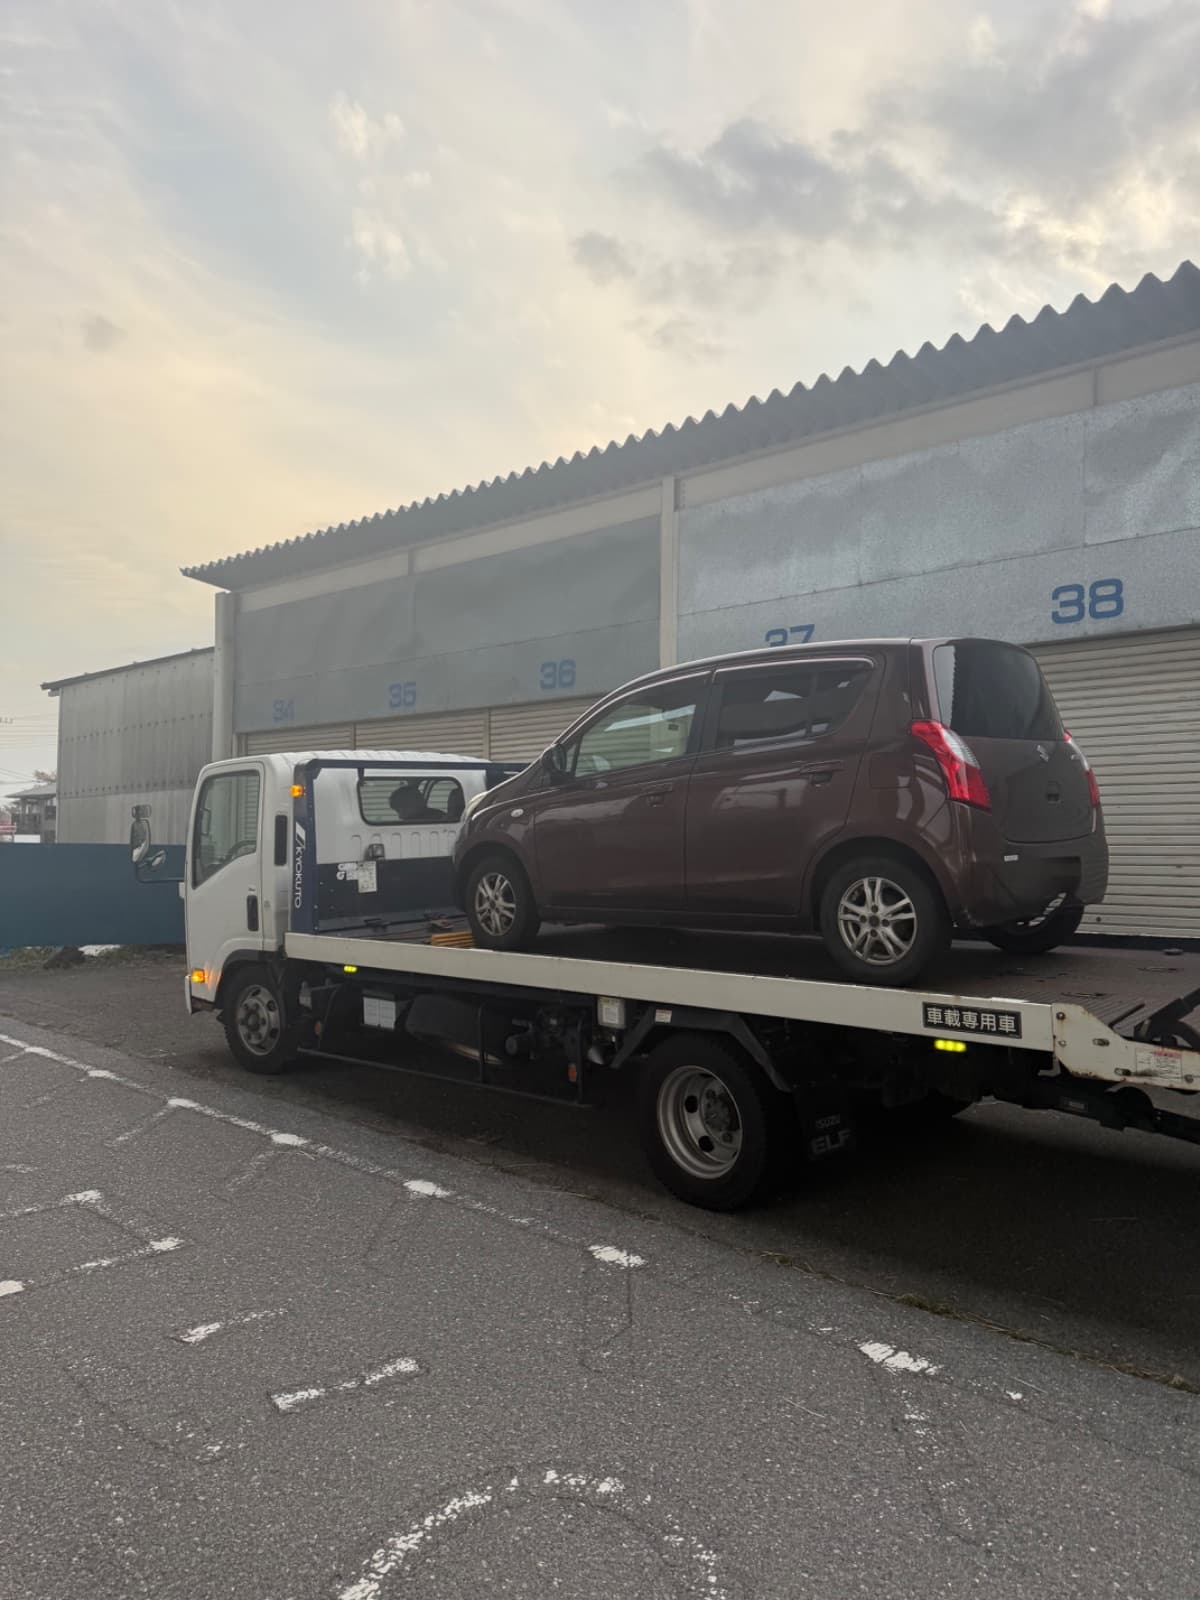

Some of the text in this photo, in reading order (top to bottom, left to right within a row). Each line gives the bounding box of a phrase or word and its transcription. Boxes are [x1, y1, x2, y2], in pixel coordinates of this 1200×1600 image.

[1051, 578, 1124, 624] 38
[764, 624, 815, 648] 37
[540, 659, 576, 689] 36
[389, 681, 416, 708] 35
[294, 846, 303, 909] KYOKUTO
[926, 1007, 1017, 1033] 車載専用車
